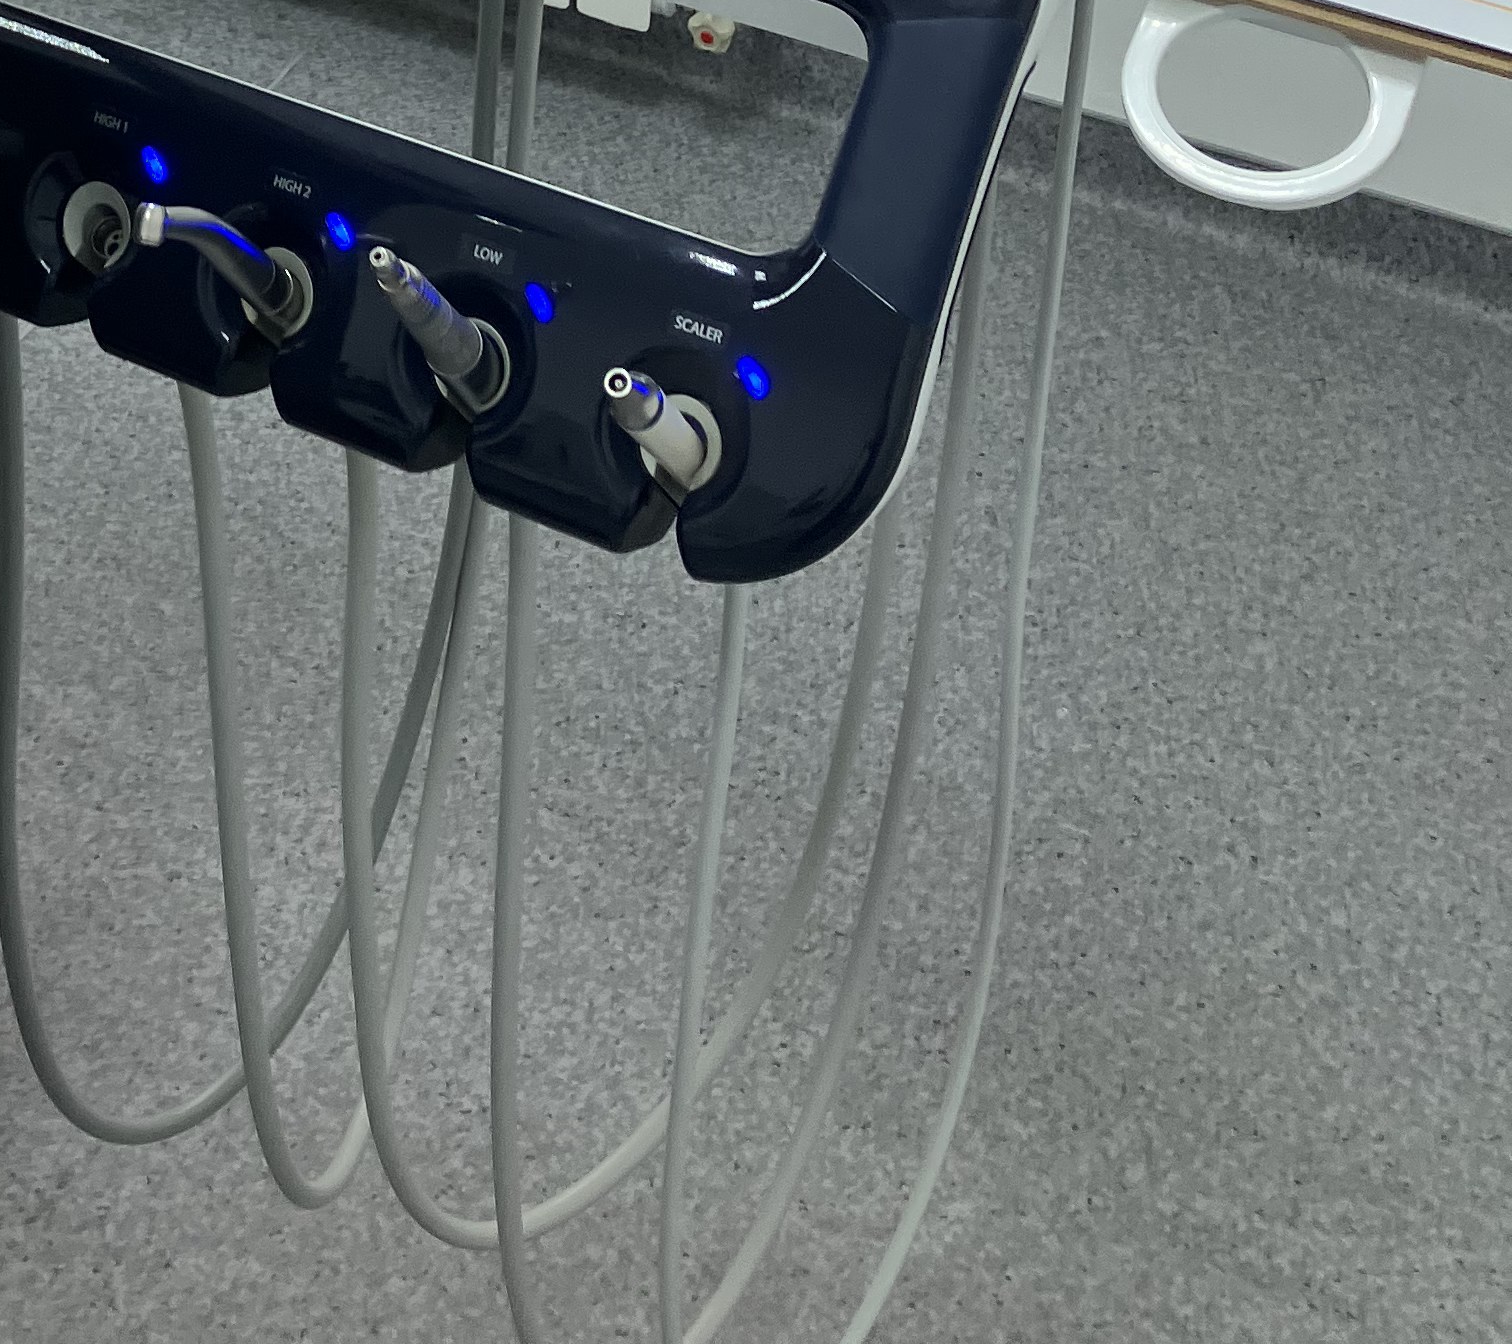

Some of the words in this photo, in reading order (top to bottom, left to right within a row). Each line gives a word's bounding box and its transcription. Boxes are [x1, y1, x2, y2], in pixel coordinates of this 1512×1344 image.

[94, 111, 121, 131] HIGH
[273, 174, 302, 195] HIGH
[473, 244, 504, 266] LOW
[673, 315, 724, 344] SCALER
